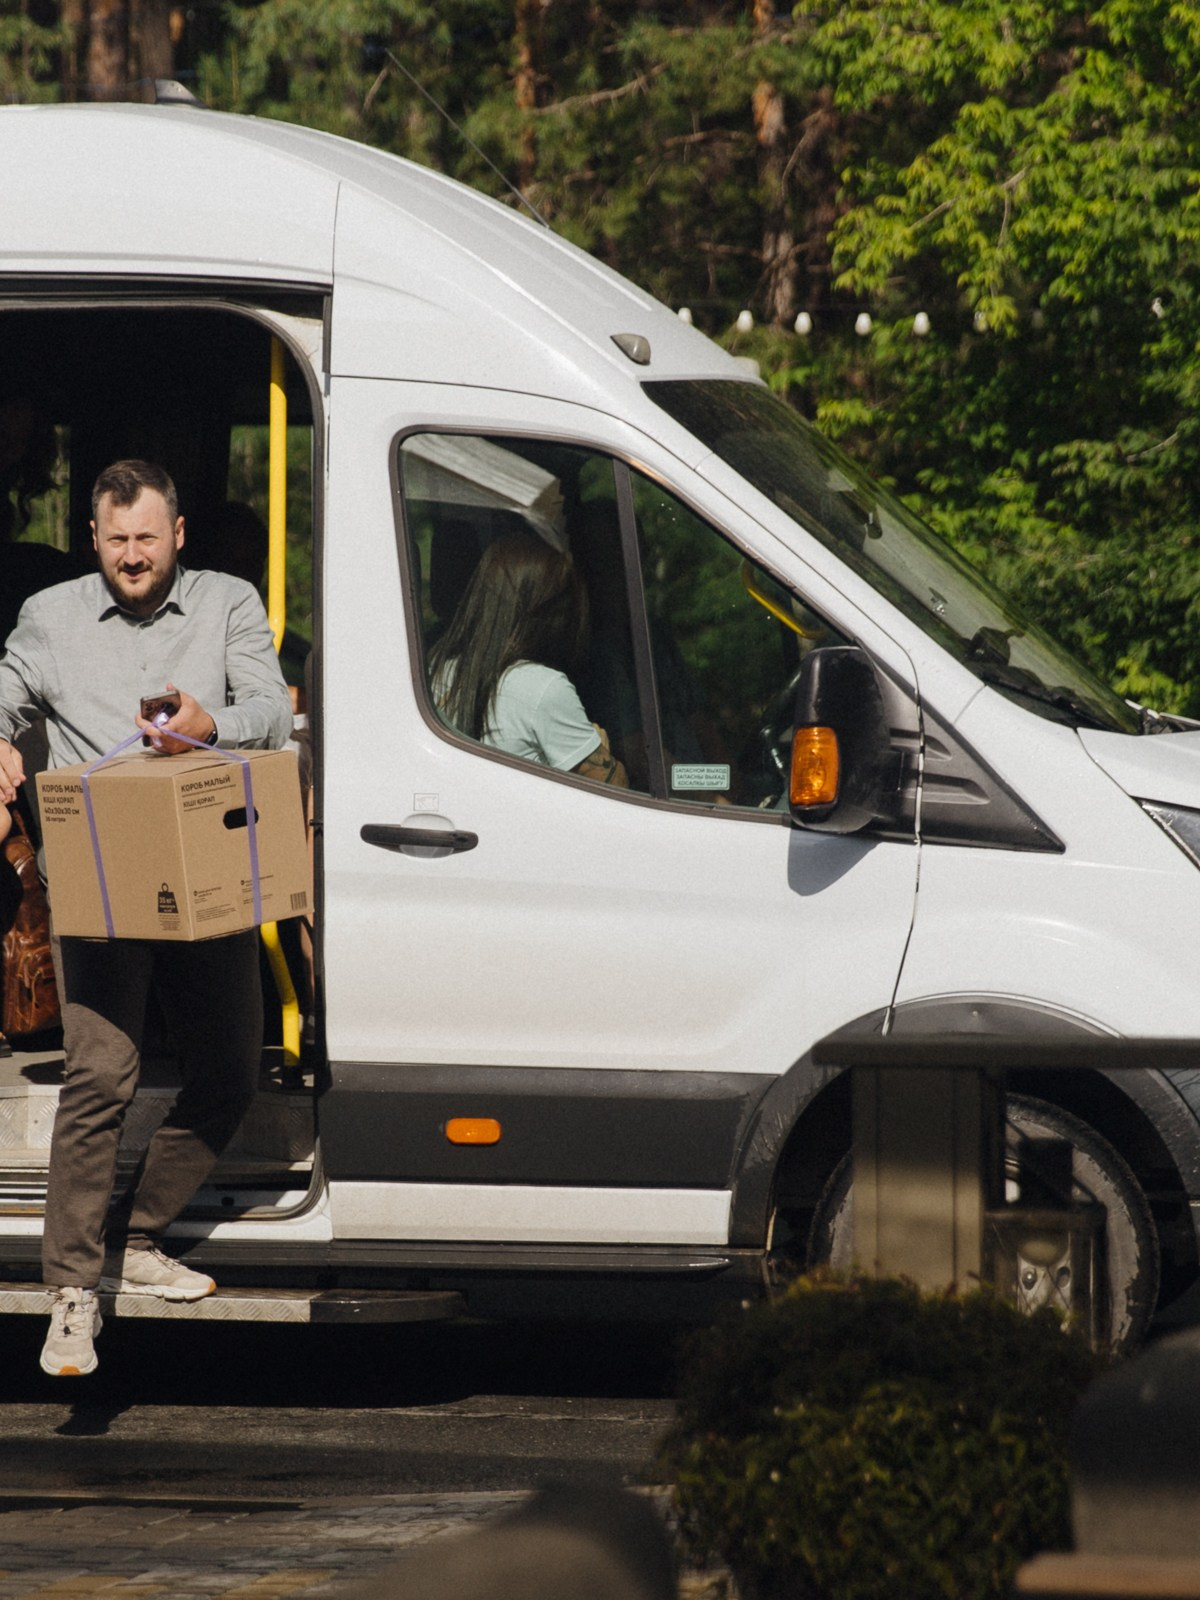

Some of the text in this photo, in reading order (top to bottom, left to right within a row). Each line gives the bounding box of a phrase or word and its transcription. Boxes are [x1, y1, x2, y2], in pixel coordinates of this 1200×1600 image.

[41, 784, 90, 793] КОРОБ МАЛЫ
[181, 781, 204, 792] КОРОБ
[204, 774, 231, 787] МАЛЫЙ
